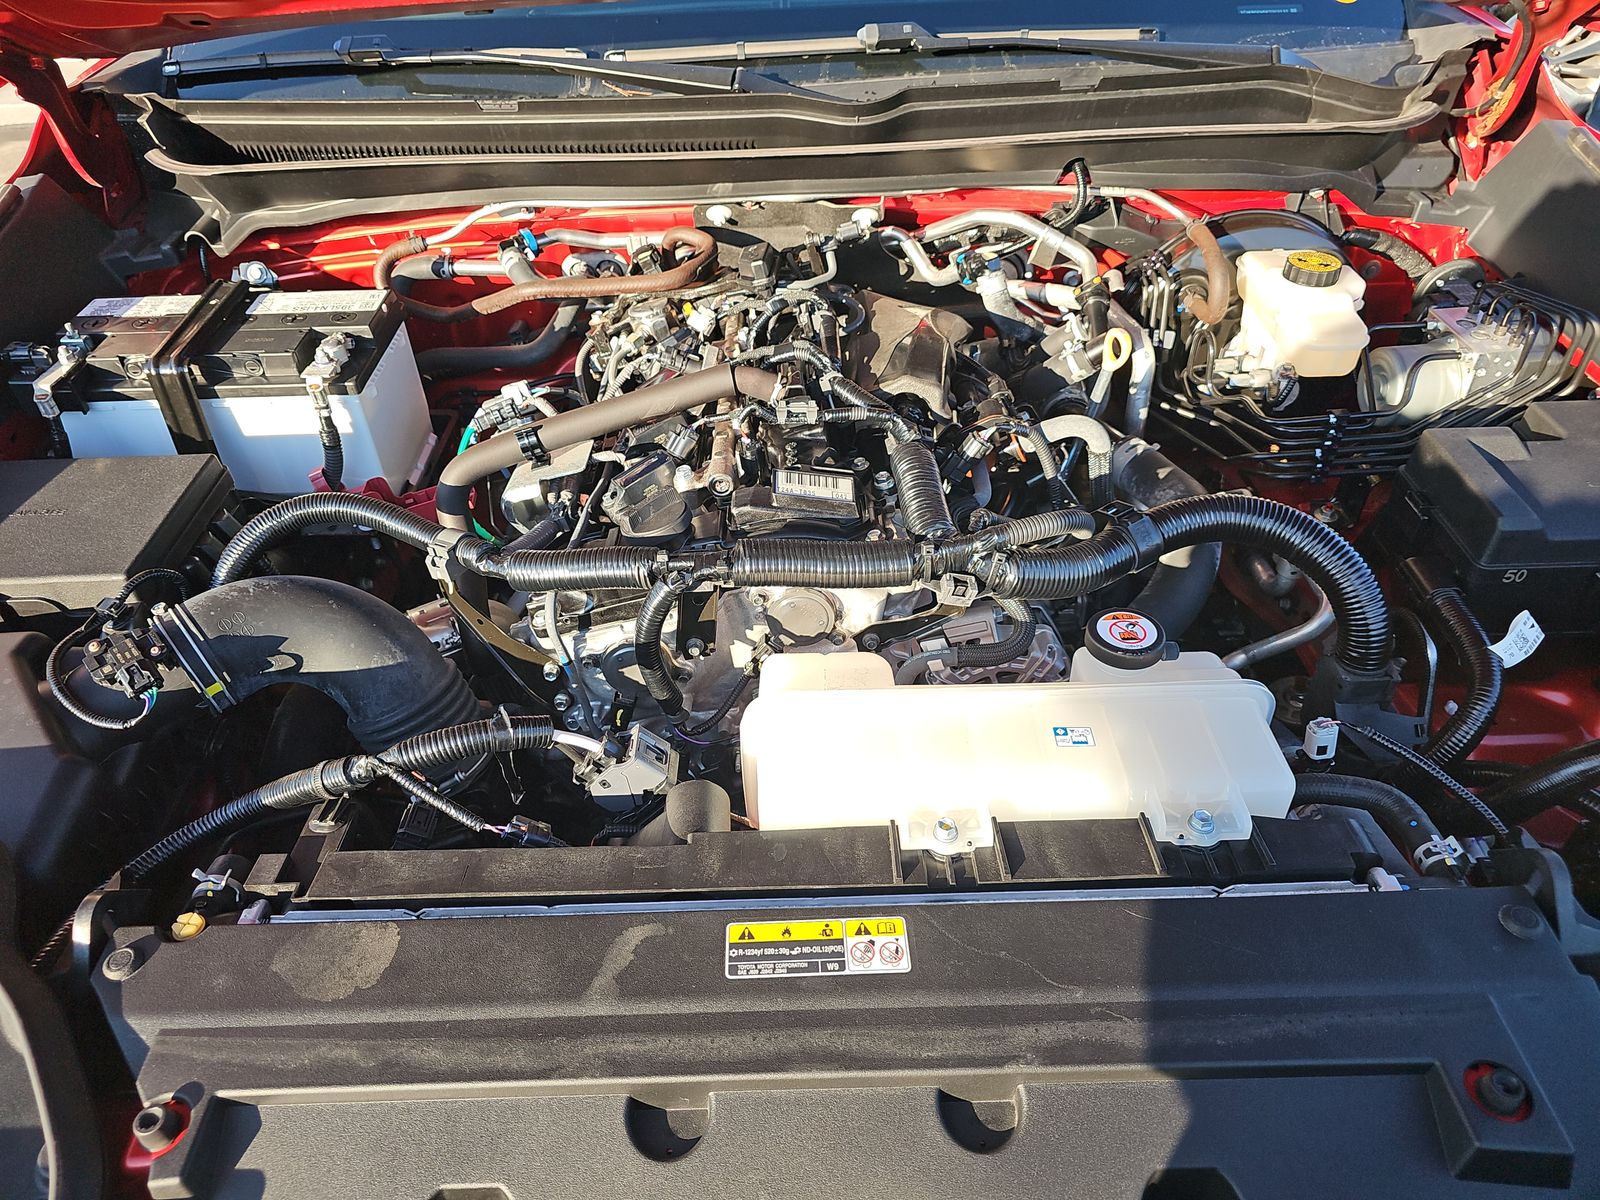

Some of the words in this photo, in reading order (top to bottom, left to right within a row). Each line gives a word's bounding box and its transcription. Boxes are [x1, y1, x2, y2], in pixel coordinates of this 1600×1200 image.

[1502, 569, 1528, 583] 50
[738, 948, 764, 957] R-1234yf
[775, 961, 809, 969] CORPORATION
[826, 962, 840, 971] W9
